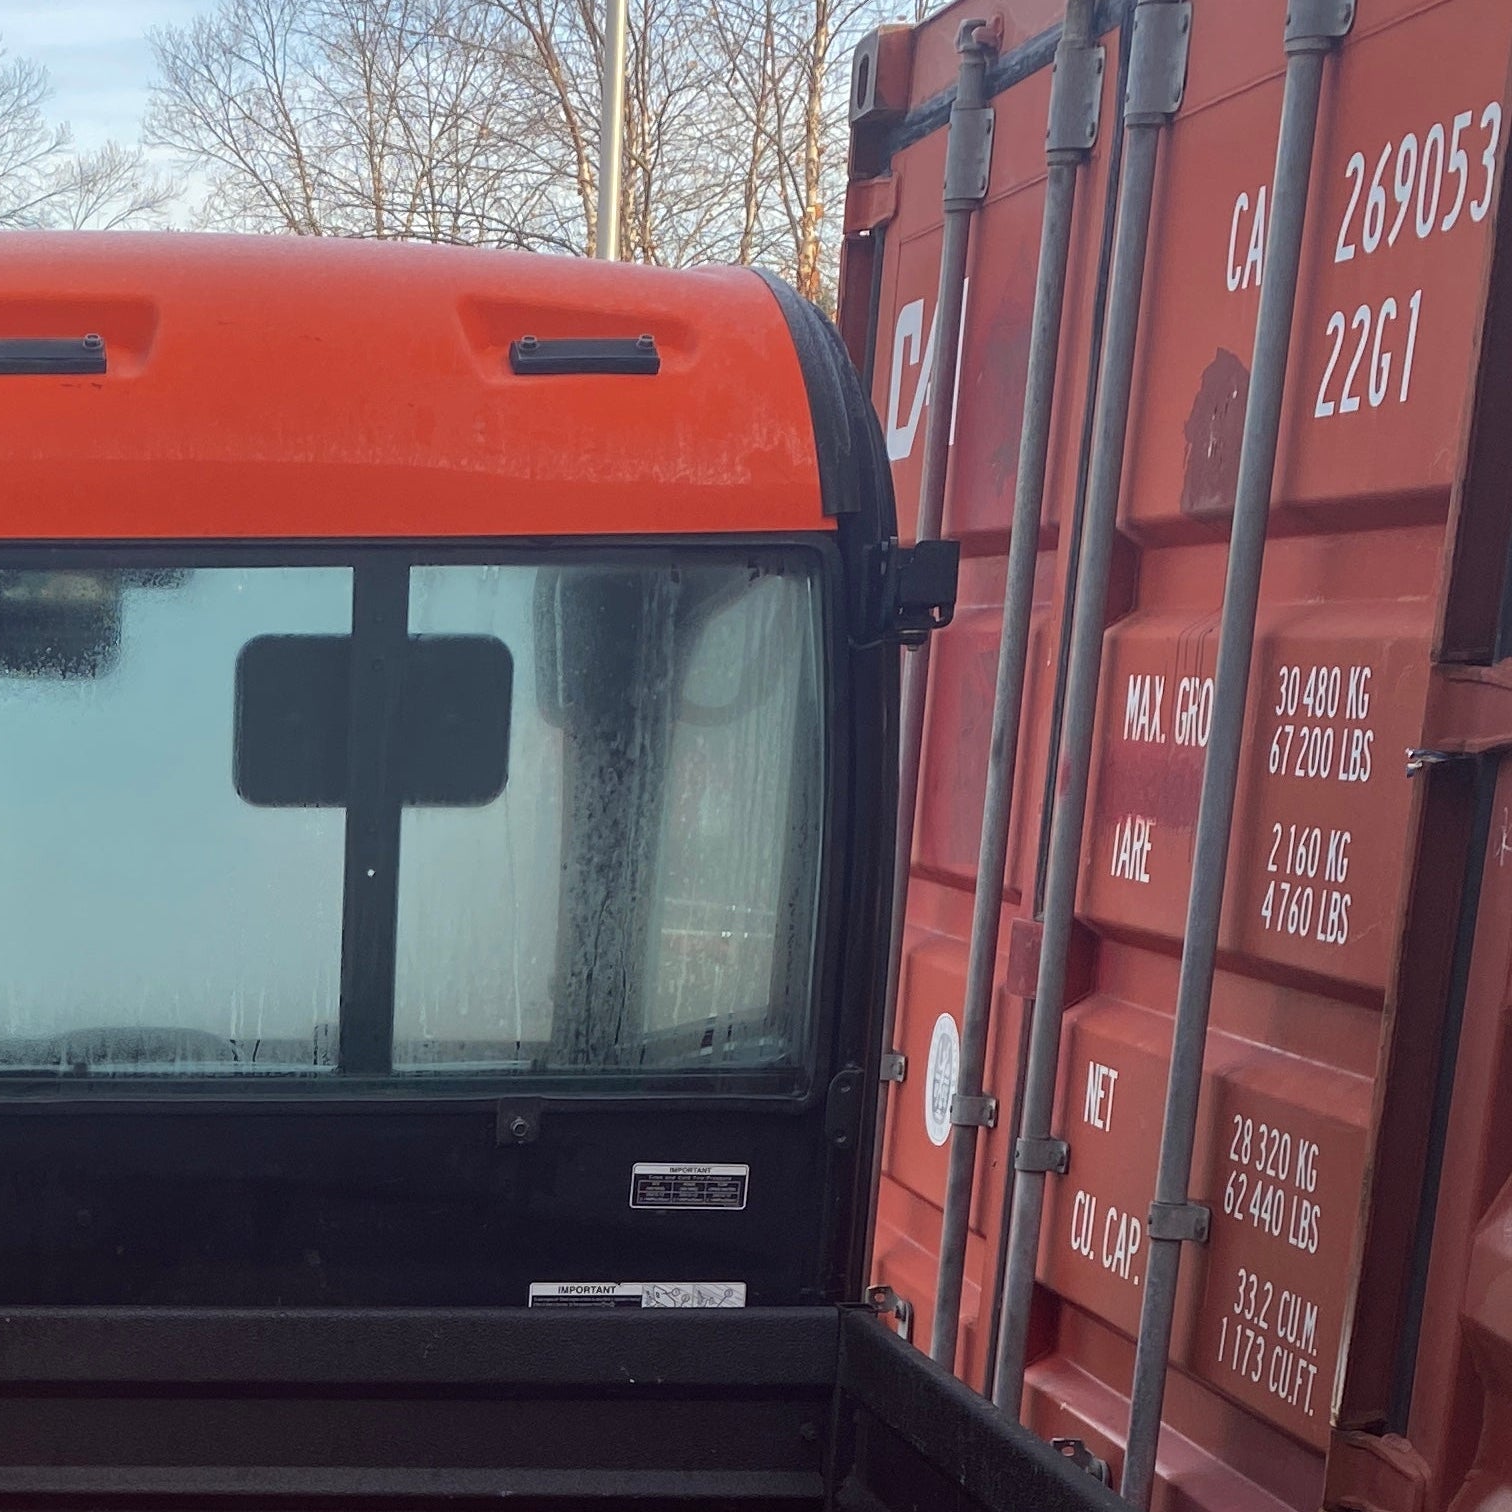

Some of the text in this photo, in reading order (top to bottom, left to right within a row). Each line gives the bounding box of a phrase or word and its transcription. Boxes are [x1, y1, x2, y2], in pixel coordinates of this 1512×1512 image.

[1227, 101, 1502, 291] CA 269053
[887, 277, 969, 460] CA
[1314, 289, 1422, 418] 22G1
[1123, 674, 1165, 743] MAX.
[1175, 677, 1215, 747] GRO
[1346, 666, 1372, 719] KG
[1339, 728, 1374, 782] LBS
[1325, 829, 1351, 883] KG
[1317, 889, 1352, 944] LBS
[1083, 1060, 1118, 1132] NET
[1295, 1138, 1319, 1193] KG
[1071, 1190, 1096, 1260] CU.
[1102, 1206, 1141, 1285] CAP.
[1288, 1195, 1320, 1254] LBS
[557, 1285, 616, 1294] IMPORTANT
[1234, 1268, 1273, 1330] 33.2
